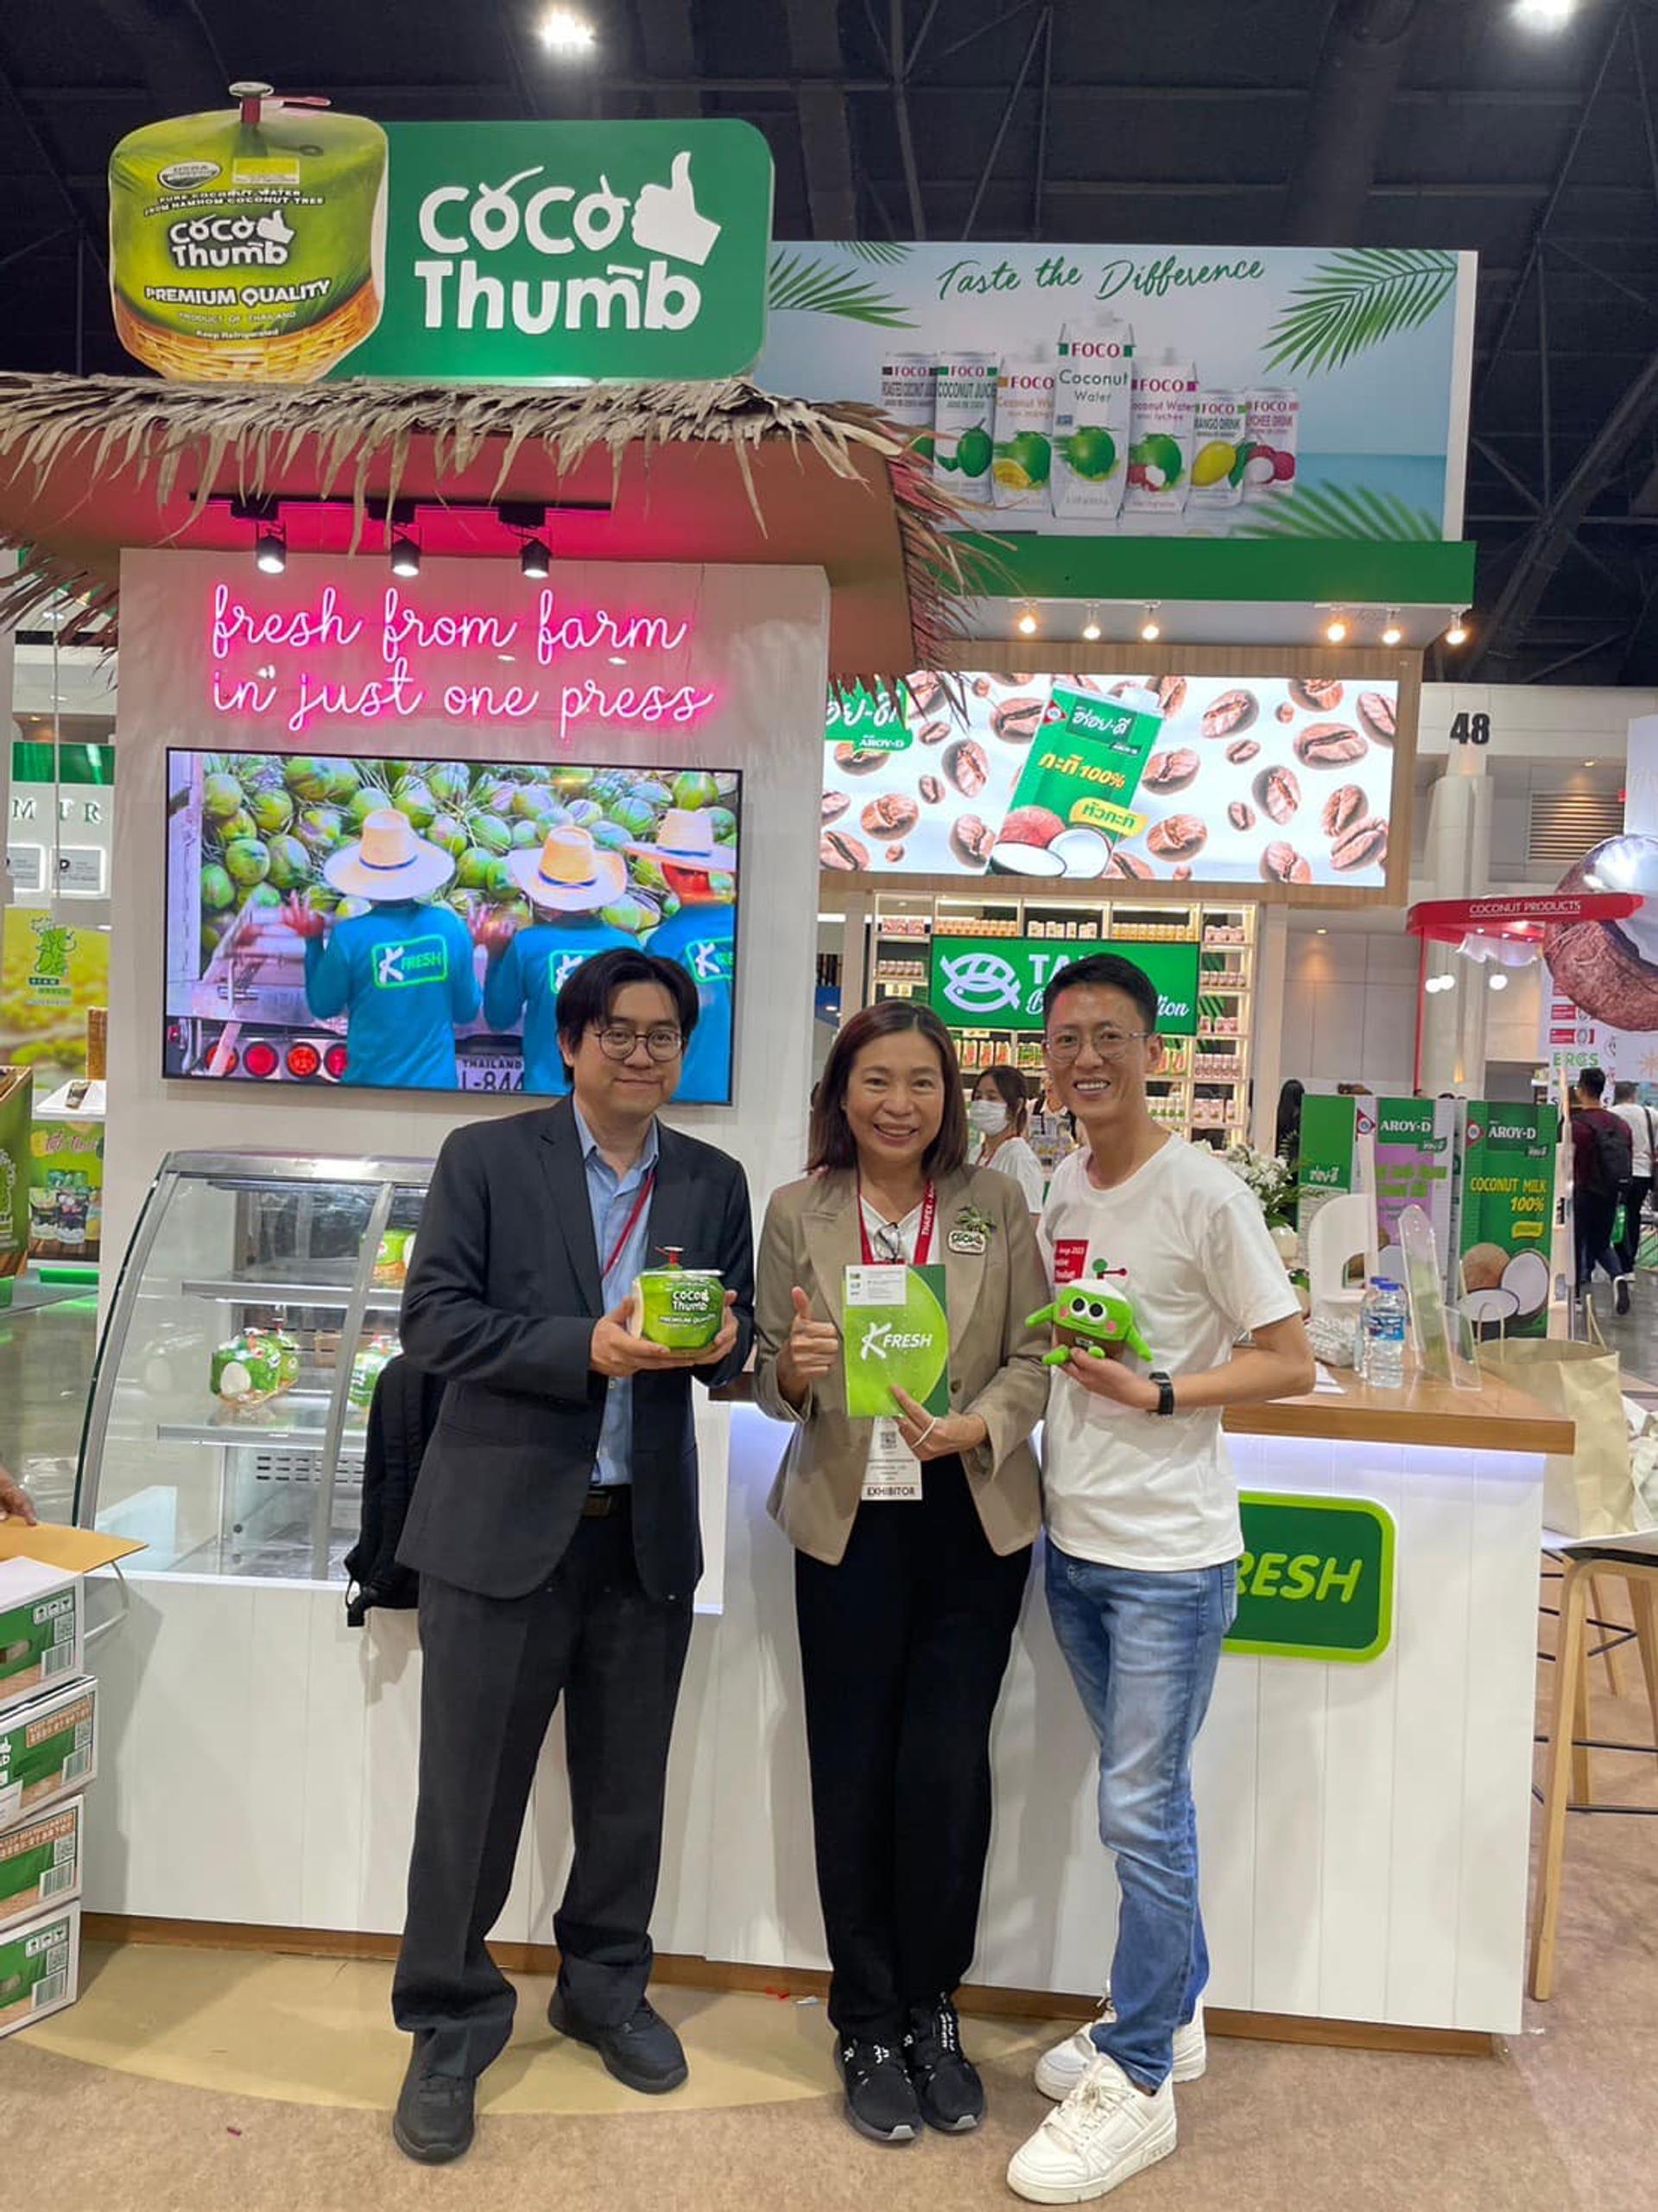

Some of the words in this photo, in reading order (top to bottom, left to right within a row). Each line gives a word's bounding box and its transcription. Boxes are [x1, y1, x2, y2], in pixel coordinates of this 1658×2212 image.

[937, 259, 1020, 300] Taste
[1035, 256, 1082, 288] the
[1095, 257, 1264, 300] Difference
[145, 286, 237, 306] PREMIUM
[240, 279, 331, 307] QUALITY
[414, 260, 701, 334] Thumb
[1072, 343, 1120, 358] FOCO
[895, 366, 927, 377] FOCO
[951, 366, 985, 377] FOCO
[1059, 370, 1129, 386] Coconut
[939, 383, 973, 398] COCONUT
[1010, 376, 1055, 390] FOCO
[1140, 378, 1185, 392] FOCO
[1074, 390, 1112, 403] Water
[1202, 402, 1235, 415] FOCO
[1254, 401, 1288, 412] FOCO
[212, 584, 364, 659] fresh
[382, 587, 519, 662] from
[536, 589, 688, 665] farm
[212, 670, 277, 713] in
[288, 657, 424, 732] just
[441, 678, 540, 716] one
[560, 679, 716, 740] press
[1450, 713, 1490, 745] 48
[1079, 765, 1125, 789] 100%
[1470, 903, 1521, 914] COCONUT
[1524, 900, 1581, 911] PRODUCTS
[462, 1059, 522, 1070] THAILAND
[1471, 1177, 1520, 1193] COCONUT
[1522, 1178, 1547, 1193] MILK
[1510, 1196, 1545, 1212] 100%
[867, 1486, 915, 1497] EXHIBITOR
